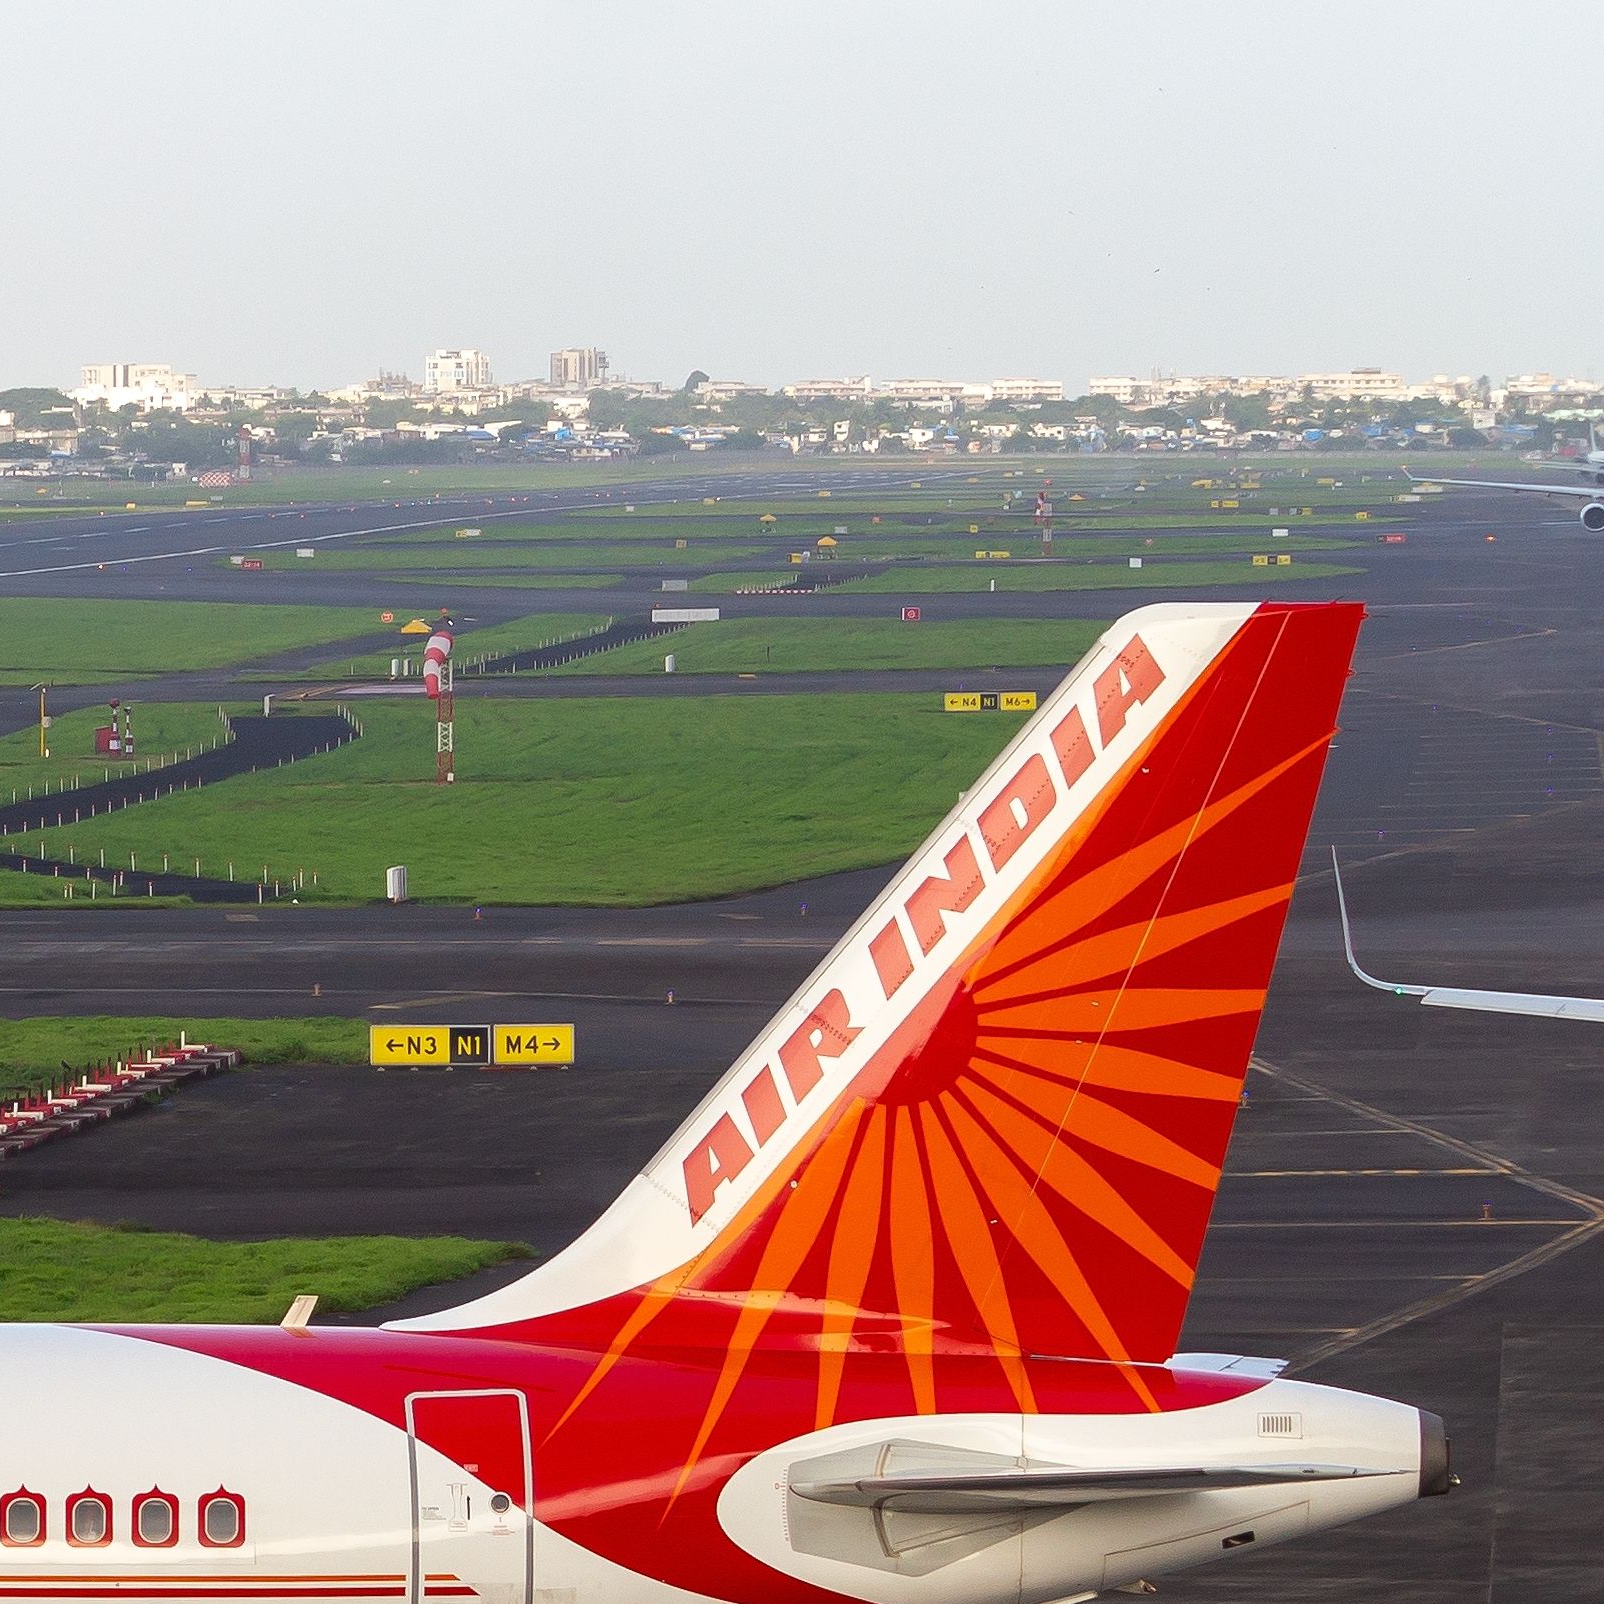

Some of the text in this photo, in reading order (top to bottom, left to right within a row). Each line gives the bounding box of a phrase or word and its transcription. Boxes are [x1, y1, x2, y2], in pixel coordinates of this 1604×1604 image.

[963, 698, 1021, 707] N4 N1 M6
[682, 633, 1166, 1228] AIR INDIA
[407, 1035, 539, 1055] N3 N1 M4
